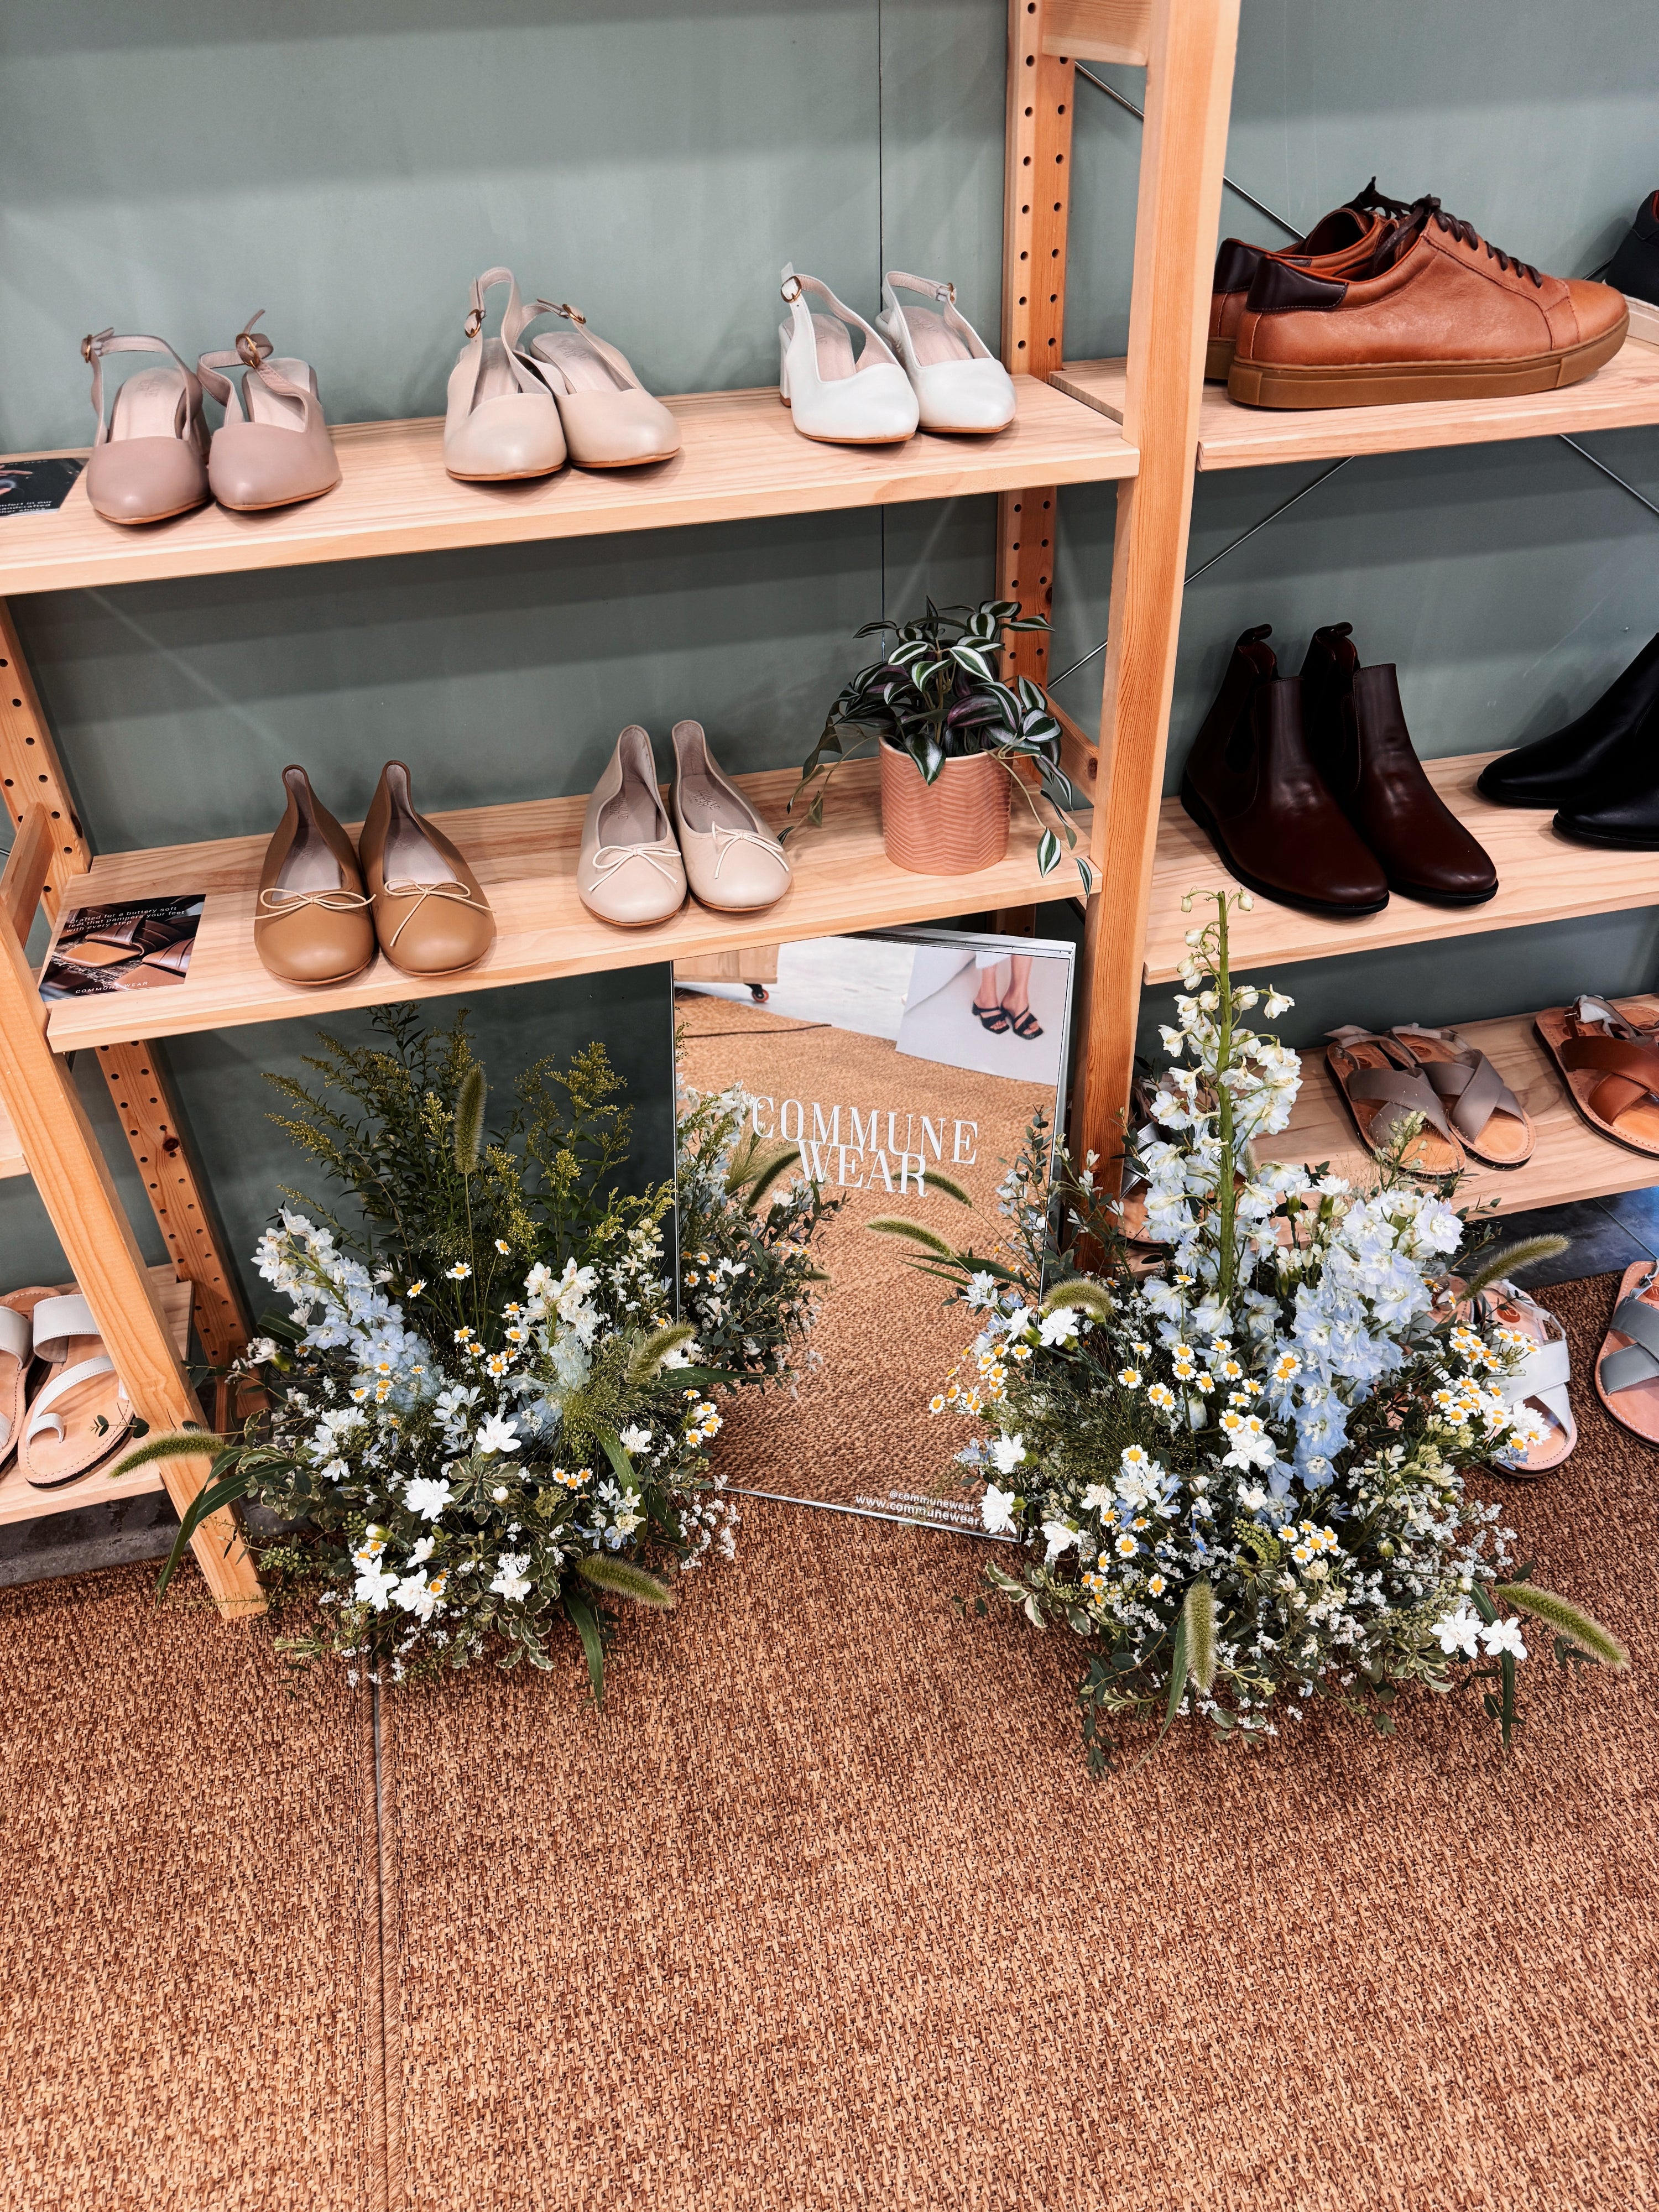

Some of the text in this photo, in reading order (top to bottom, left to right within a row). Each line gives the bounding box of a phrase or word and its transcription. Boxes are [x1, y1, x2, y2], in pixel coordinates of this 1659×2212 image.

[70, 915, 101, 924] Crafted
[106, 914, 144, 924] pampers
[75, 985, 121, 994] COMMUNE
[752, 1095, 979, 1164] COMMUNE
[799, 1140, 928, 1197] WEAR
[889, 1489, 975, 1513] @communewear
